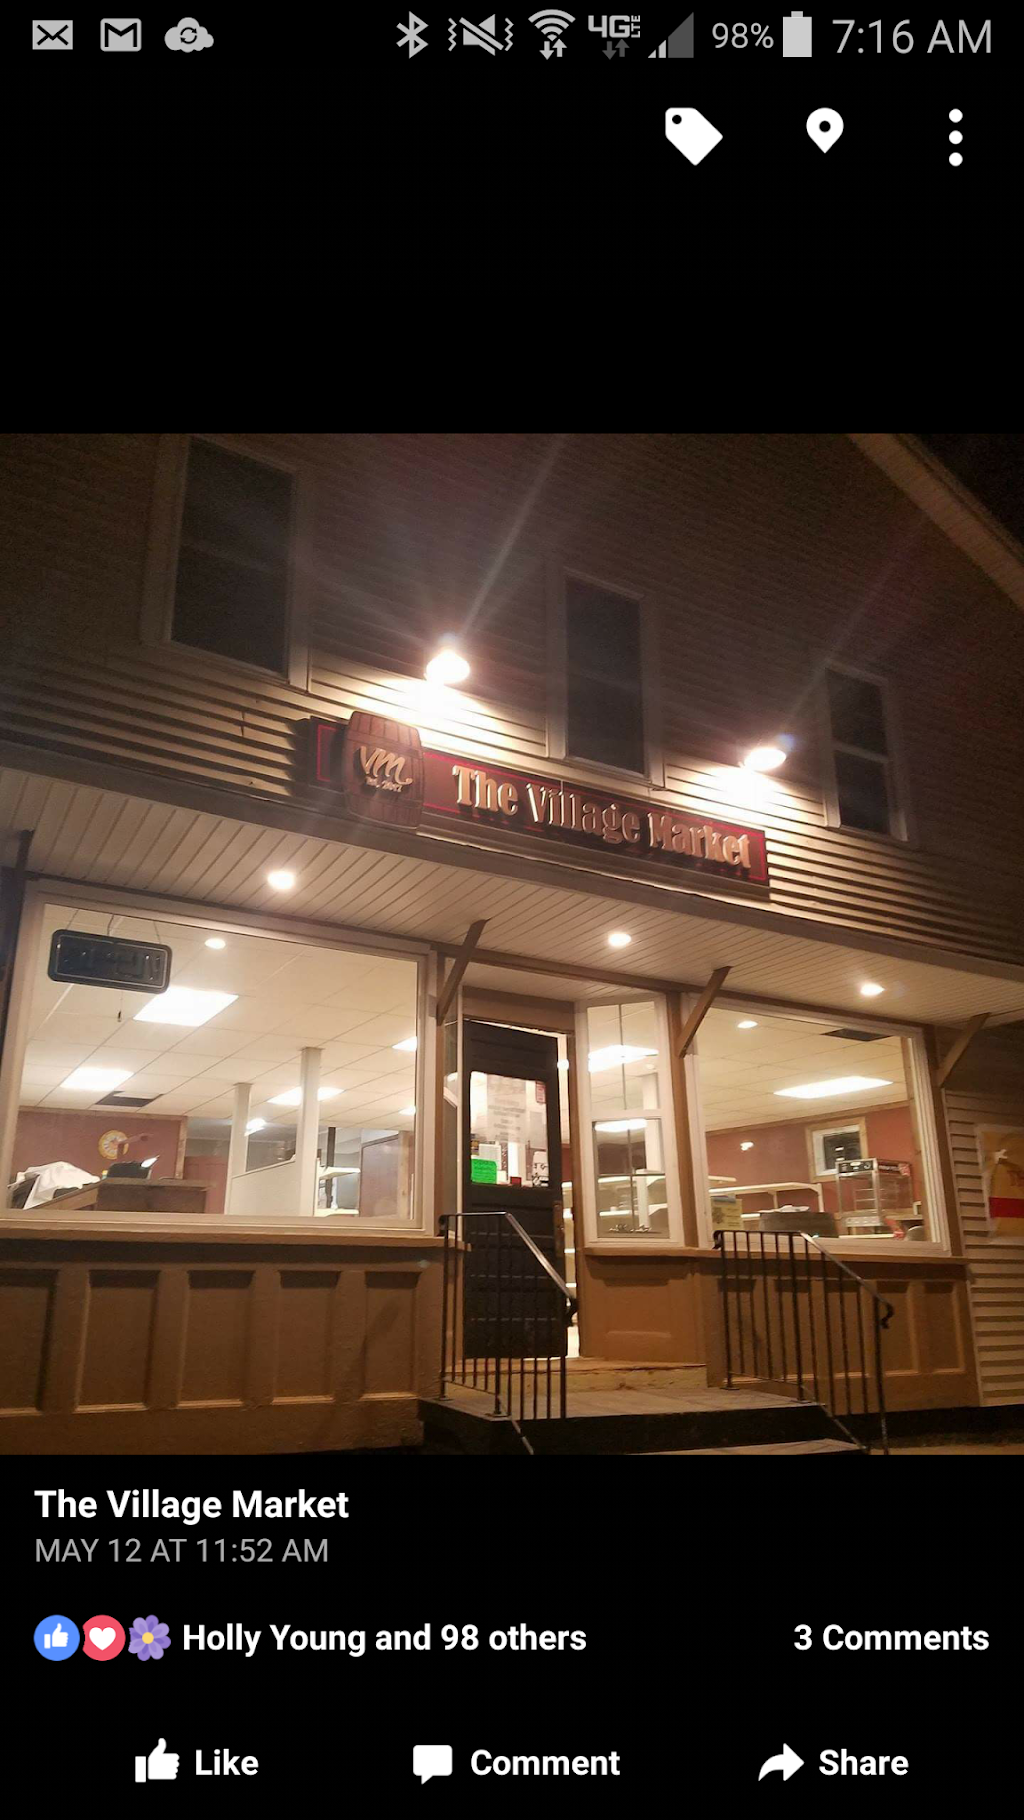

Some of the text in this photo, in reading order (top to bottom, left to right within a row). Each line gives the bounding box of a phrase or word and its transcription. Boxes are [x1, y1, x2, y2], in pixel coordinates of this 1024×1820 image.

[452, 765, 751, 868] The Village Market
